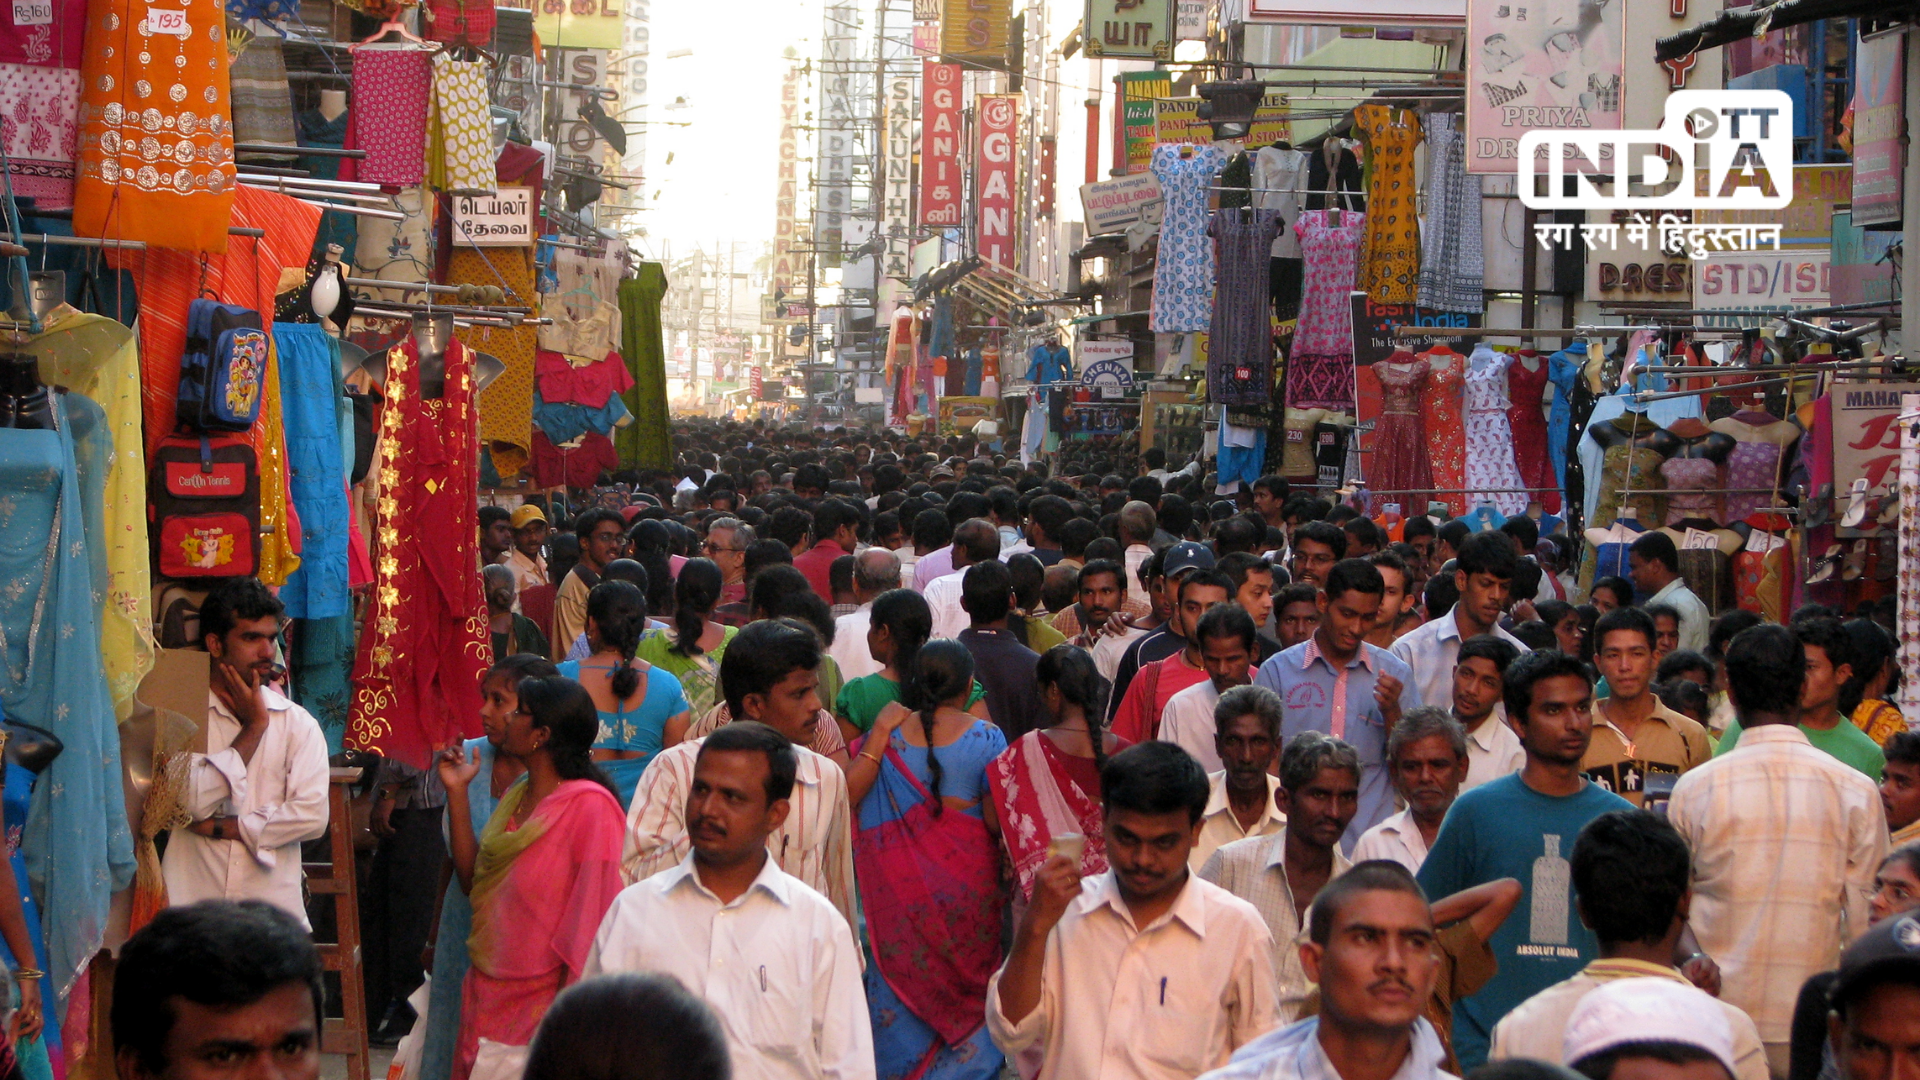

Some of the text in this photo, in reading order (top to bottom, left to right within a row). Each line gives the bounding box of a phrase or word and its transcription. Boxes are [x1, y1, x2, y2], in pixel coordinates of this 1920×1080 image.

[158, 14, 184, 29] 195
[1126, 79, 1171, 102] ANAND
[1501, 105, 1592, 127] PRIYA
[933, 89, 953, 181] GANI
[775, 66, 797, 294] JEYACHANDRAN
[886, 81, 910, 275] SAKUNTHALA
[982, 132, 1011, 273] GANI
[461, 219, 528, 238] தேவை
[1599, 263, 1692, 292] DRES
[1371, 337, 1385, 348] The
[751, 367, 763, 397] Bata
[1083, 362, 1130, 384] CHENNAI
[1287, 430, 1302, 440] 230
[1687, 528, 1717, 549] 150
[1516, 945, 1579, 958] ABSOLUT INDIA
